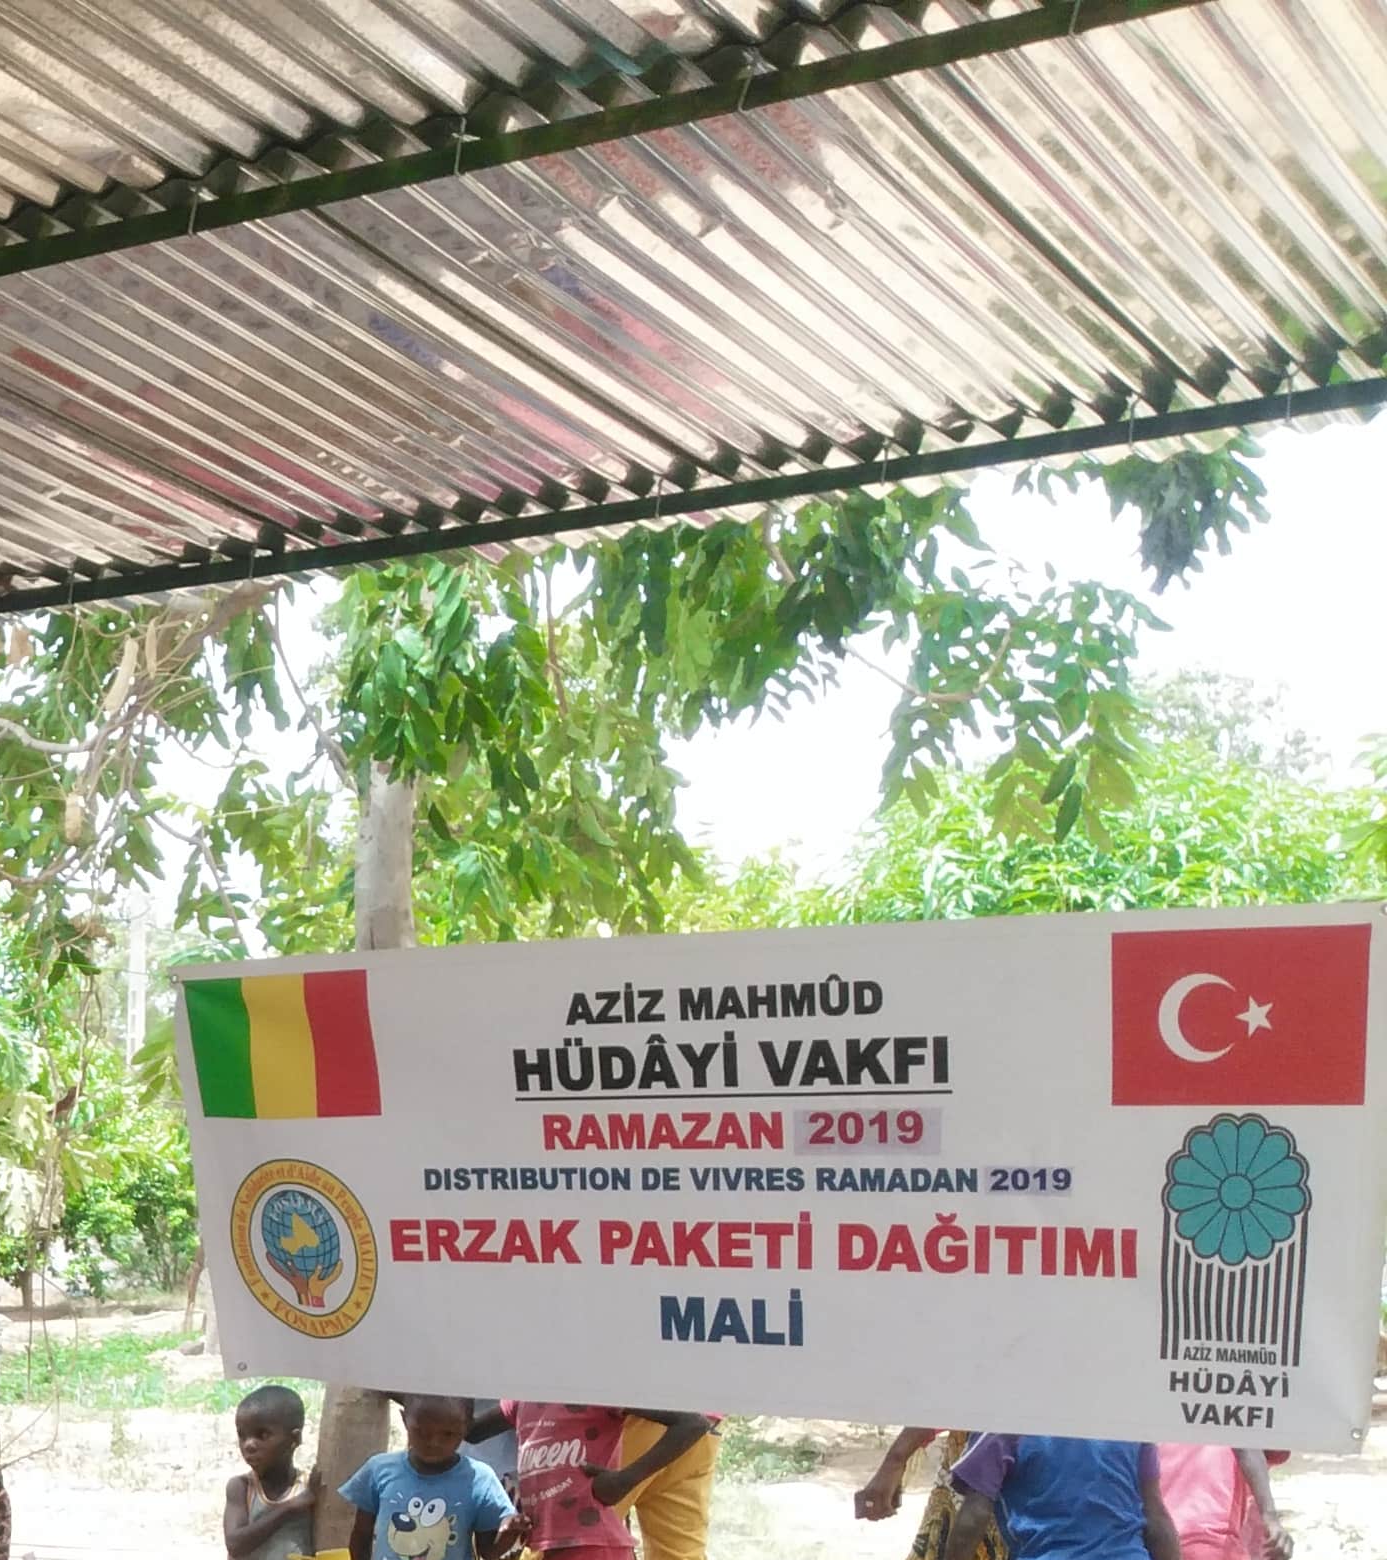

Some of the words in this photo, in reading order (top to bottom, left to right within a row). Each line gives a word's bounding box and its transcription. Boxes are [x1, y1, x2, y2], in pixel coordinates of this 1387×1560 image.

[566, 982, 666, 1025] AZİZ
[679, 974, 883, 1021] MAHMÛD
[513, 1031, 739, 1091] HÜDÂYİ
[758, 1036, 949, 1087] VAKFI
[542, 1111, 784, 1150] RAMAZAN
[809, 1110, 924, 1145] 2019
[424, 1167, 631, 1192] DISTRIBUTION
[641, 1168, 681, 1192] DE
[690, 1167, 805, 1192] VIVRES
[816, 1168, 978, 1192] RAMADAN
[990, 1168, 1072, 1192] 2019
[389, 1219, 582, 1264] ERZAK
[599, 1211, 813, 1269] PAKETİ
[838, 1212, 1138, 1278] DAĞITIMI
[660, 1288, 804, 1346] MALİ
[1183, 1342, 1212, 1362] AZİZ
[1215, 1346, 1277, 1366] MAHMÛD
[1169, 1367, 1289, 1398] HÜDÂYİ
[1181, 1402, 1274, 1428] VAKFI
